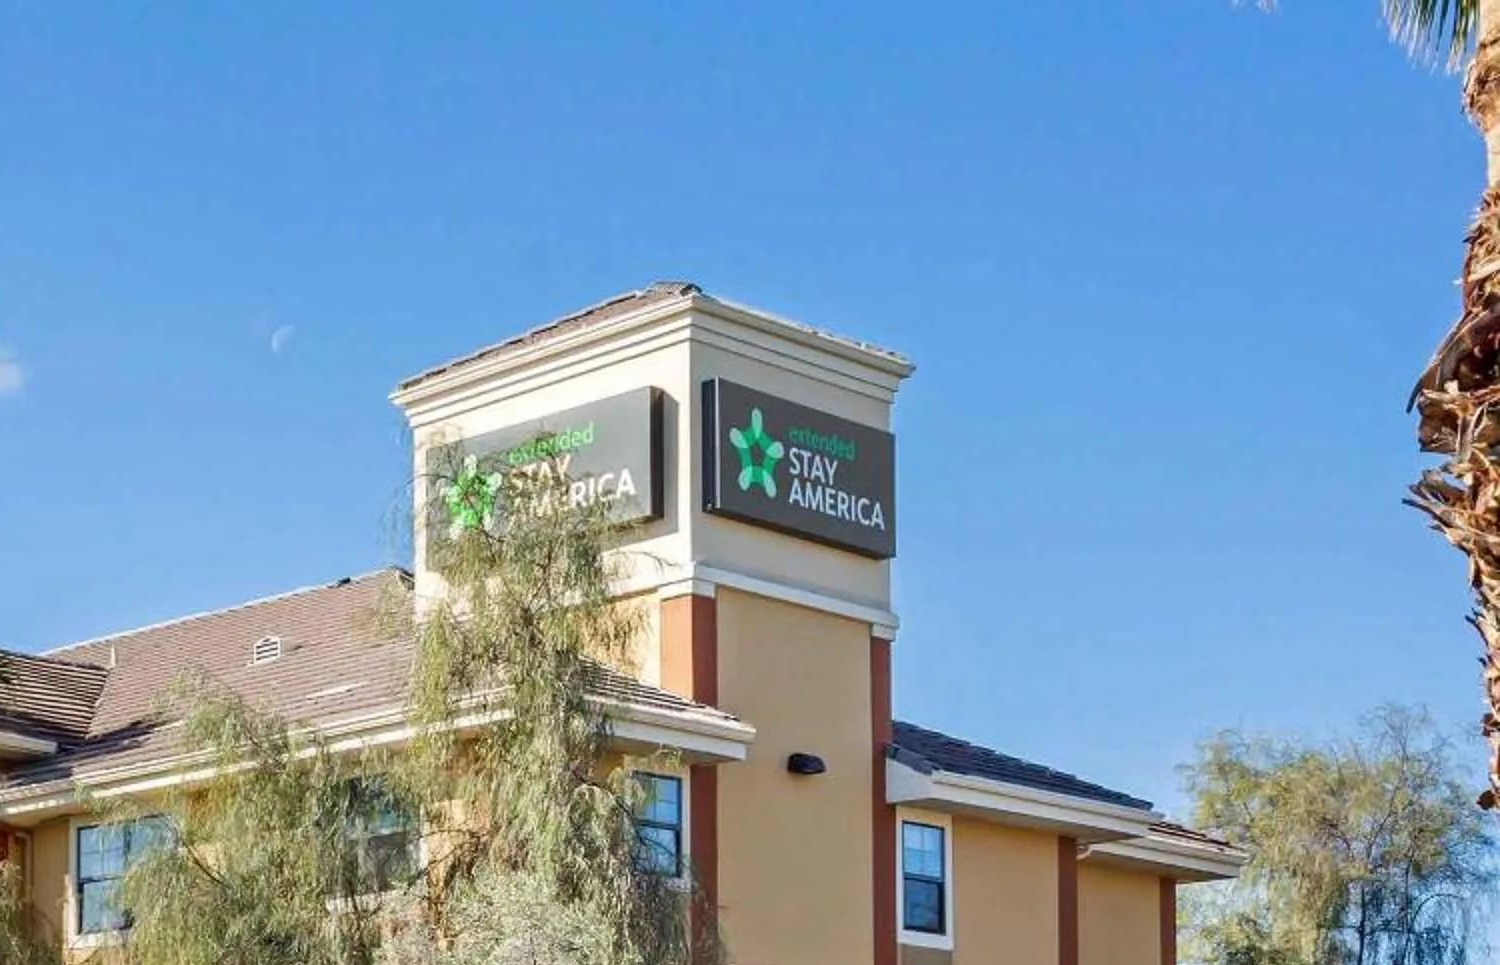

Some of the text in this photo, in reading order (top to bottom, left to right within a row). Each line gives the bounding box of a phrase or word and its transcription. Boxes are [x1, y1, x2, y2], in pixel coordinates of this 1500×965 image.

[788, 427, 856, 461] extended
[789, 447, 838, 486] STAY
[789, 478, 885, 530] AMERICA
